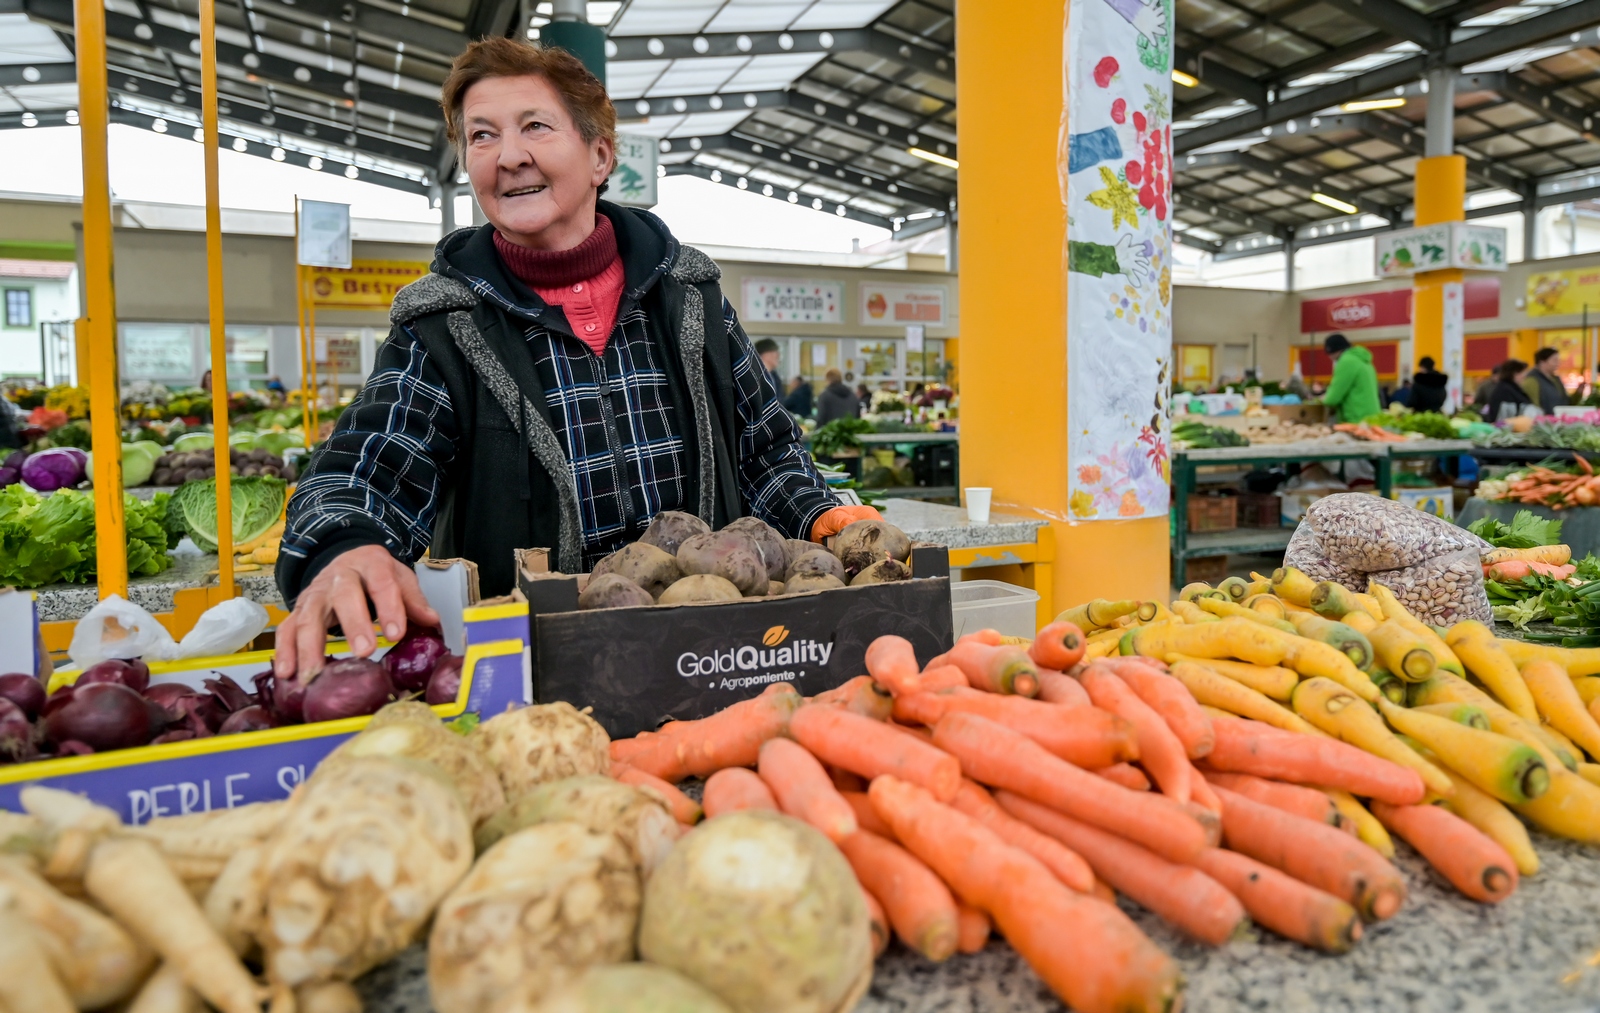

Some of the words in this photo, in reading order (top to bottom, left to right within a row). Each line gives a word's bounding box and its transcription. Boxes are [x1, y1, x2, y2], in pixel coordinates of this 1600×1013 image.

[765, 295, 824, 311] PLASTIMA
[676, 639, 834, 678] GoldQuality
[720, 670, 795, 690] Agroponiente
